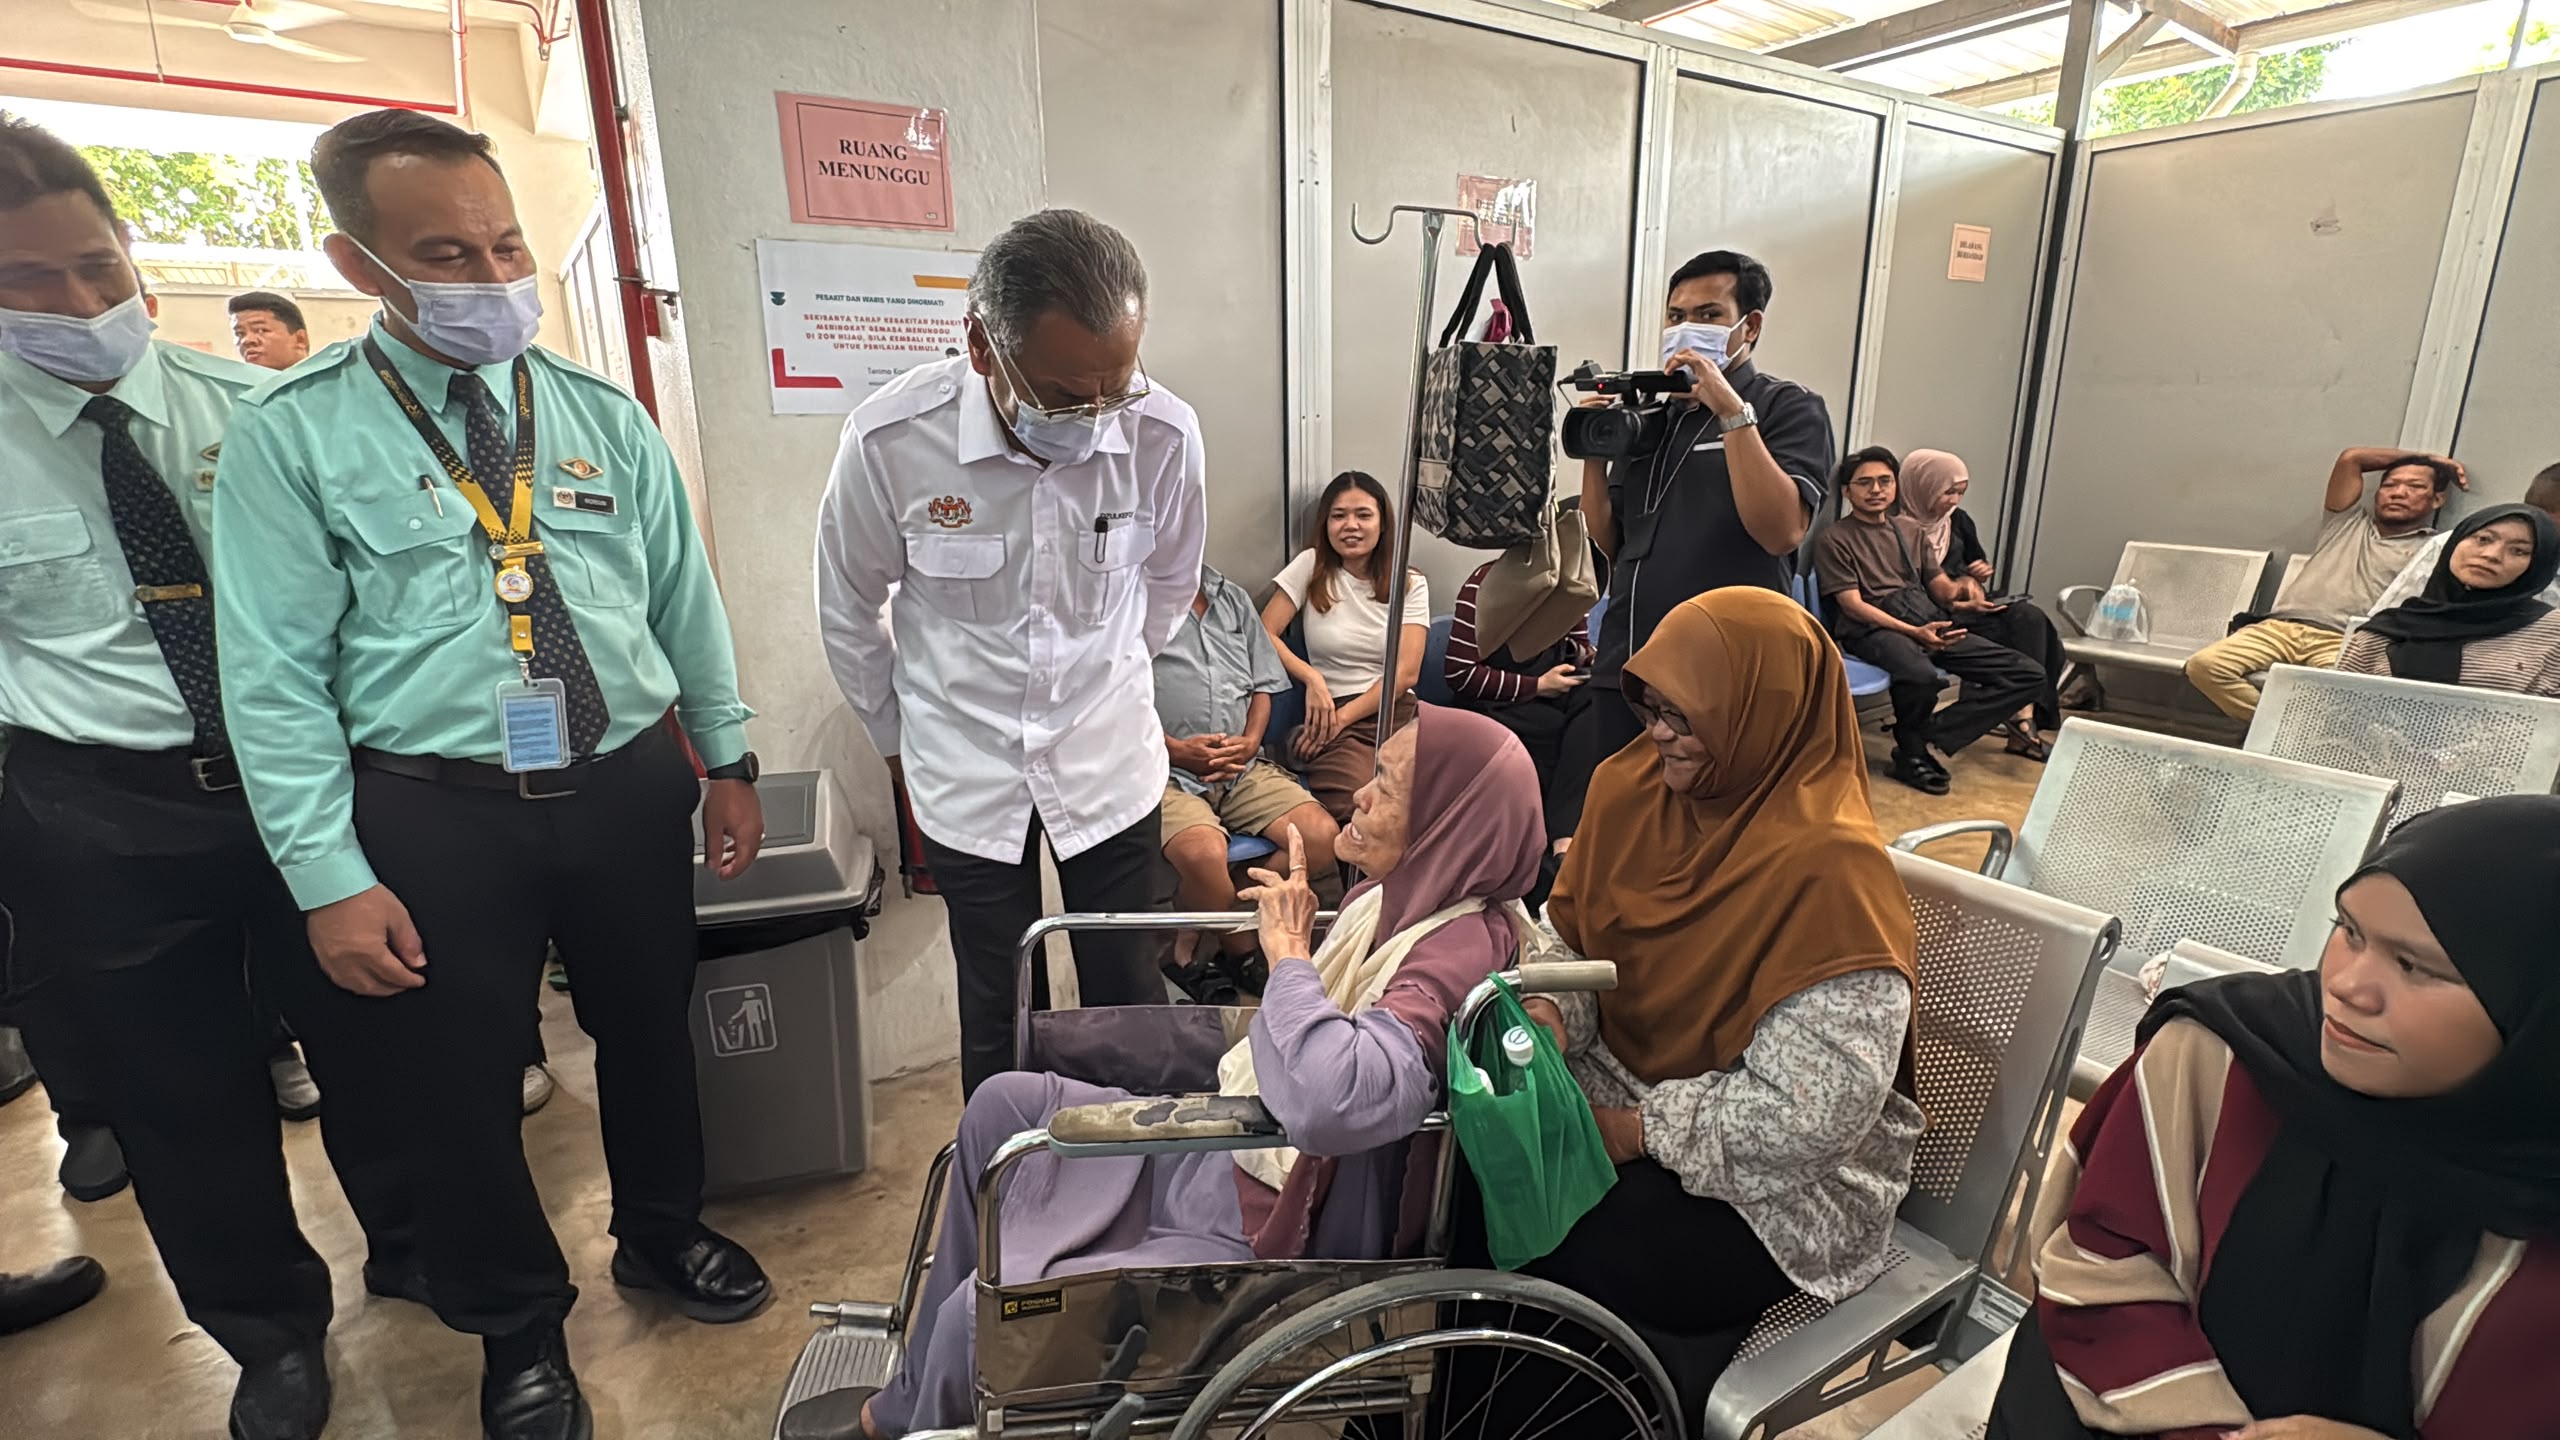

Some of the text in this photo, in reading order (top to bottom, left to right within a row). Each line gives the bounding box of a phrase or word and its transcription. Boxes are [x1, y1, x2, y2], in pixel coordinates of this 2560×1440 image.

[839, 139, 907, 161] RUANG
[818, 160, 930, 186] MENUNGGU
[815, 293, 844, 302] PESAKIT
[907, 298, 944, 306] DIHORMATI
[803, 313, 962, 326] SEKIRANYA TAHAP KESAKITAN PESAKIT
[816, 323, 950, 335] MENINGKAT SEMASA MENUNGGU
[806, 332, 815, 340] DI
[890, 335, 924, 343] KEMBALI
[926, 336, 936, 344] KE
[863, 343, 905, 351] PENILAIAN
[867, 367, 892, 375] Terima
